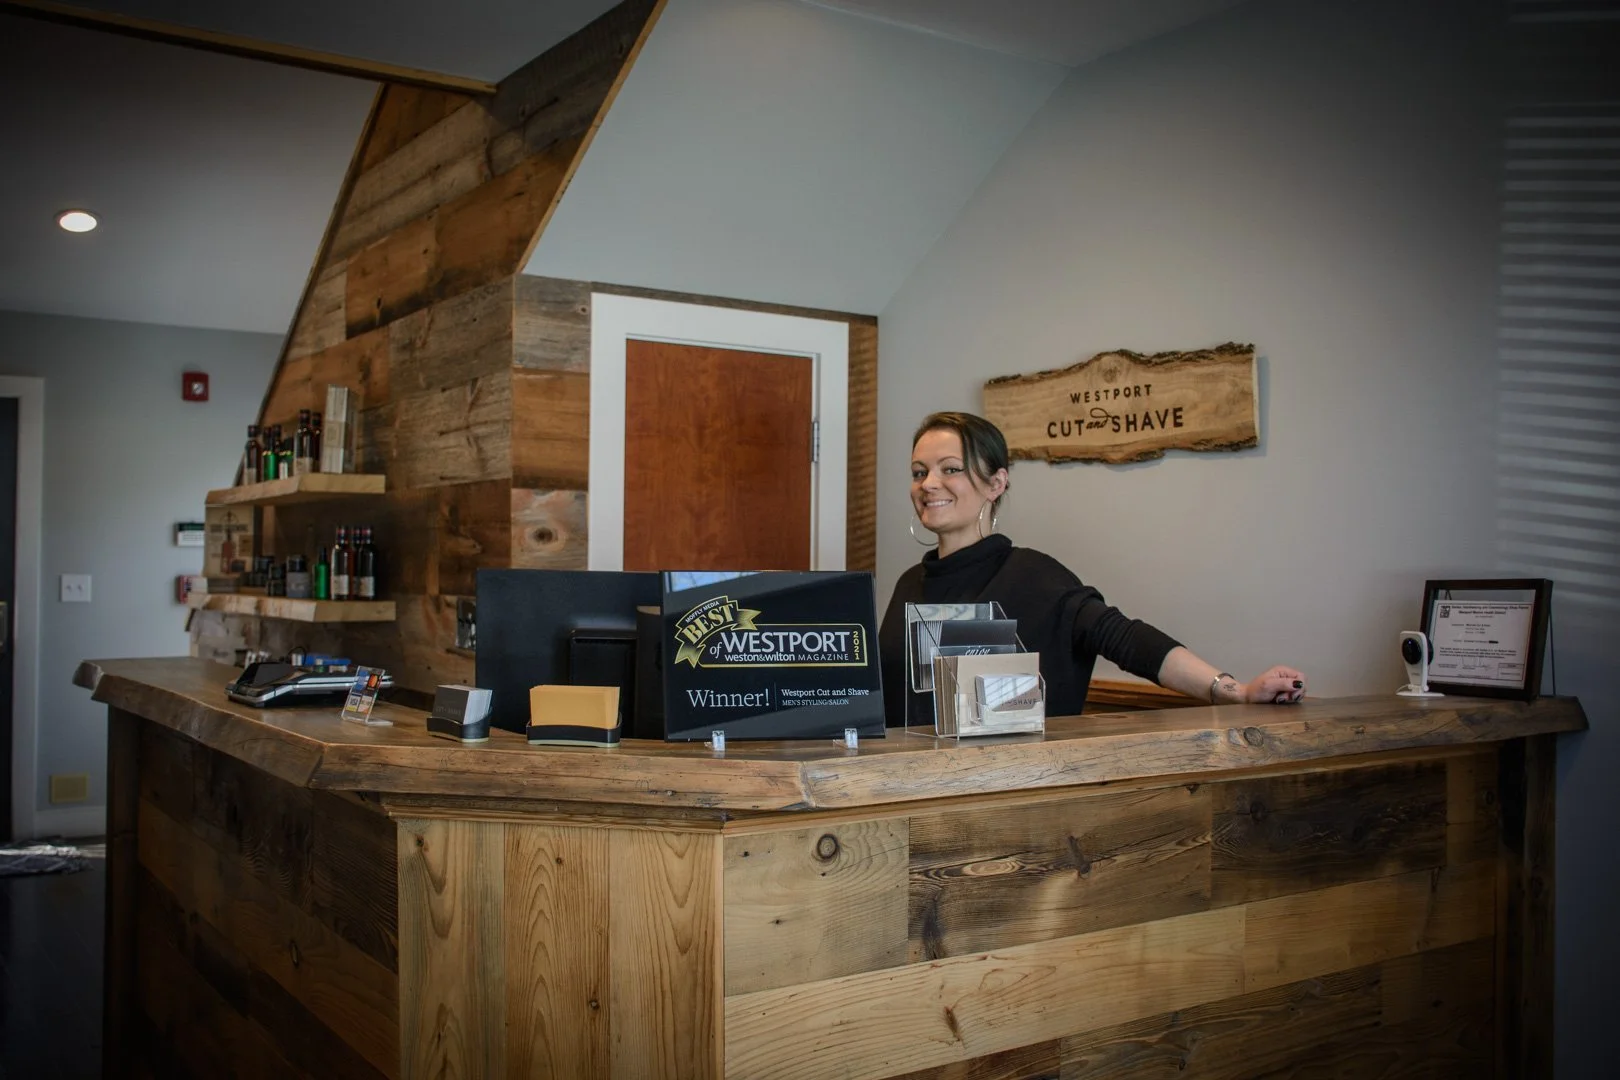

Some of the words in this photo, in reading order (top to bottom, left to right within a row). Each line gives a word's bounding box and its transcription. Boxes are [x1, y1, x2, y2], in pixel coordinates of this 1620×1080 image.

[1070, 384, 1152, 404] WESTPORT
[1047, 419, 1084, 438] CUT
[1086, 407, 1112, 430] and
[1111, 407, 1184, 433] SHAVE
[685, 607, 704, 623] MOFFLY
[702, 600, 720, 611] MEDIA
[682, 603, 734, 645] BEST
[709, 641, 723, 659] of
[720, 631, 850, 653] WESTPORT
[797, 653, 849, 661] MAGAZINE
[686, 688, 770, 708] Winner!
[781, 688, 815, 698] Westport
[816, 688, 830, 696] Cut
[831, 688, 847, 696] and
[847, 688, 870, 696] Shave
